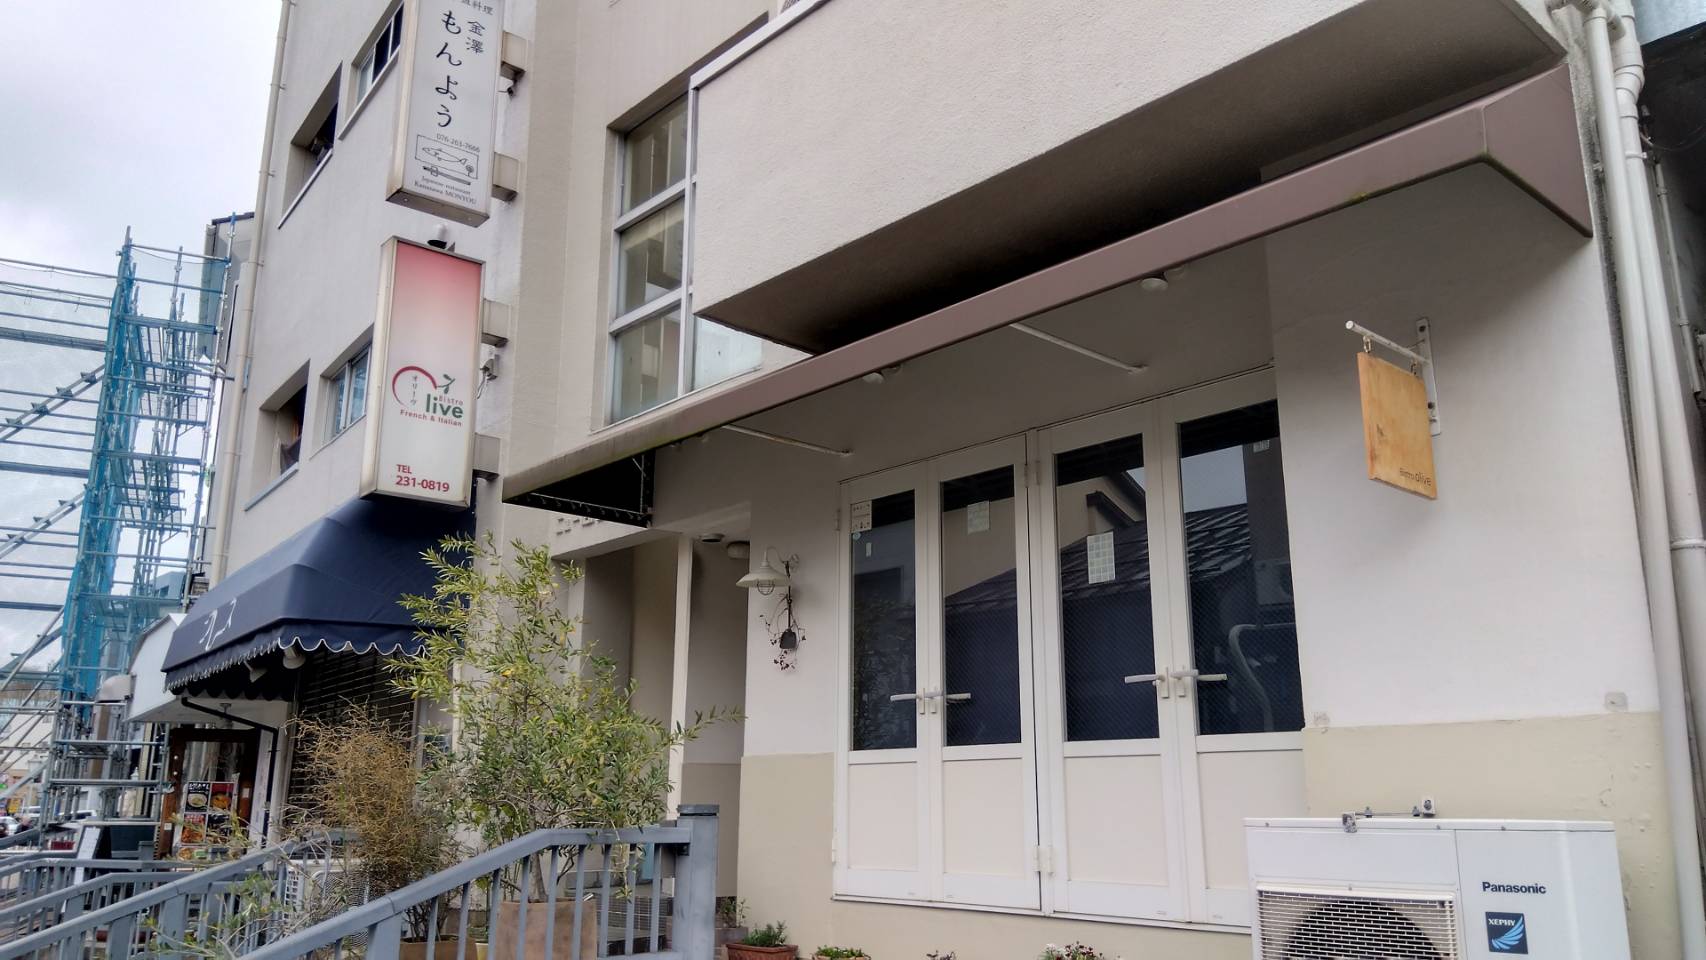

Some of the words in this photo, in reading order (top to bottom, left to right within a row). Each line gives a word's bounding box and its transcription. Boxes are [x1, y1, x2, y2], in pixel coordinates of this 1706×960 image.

[435, 10, 462, 128] もんよう
[400, 409, 427, 421] French
[438, 417, 462, 427] Italian
[396, 464, 412, 474] TEL
[396, 475, 450, 492] 231-0819
[1482, 881, 1547, 894] Panasonic
[1488, 918, 1516, 926] XEPHY
